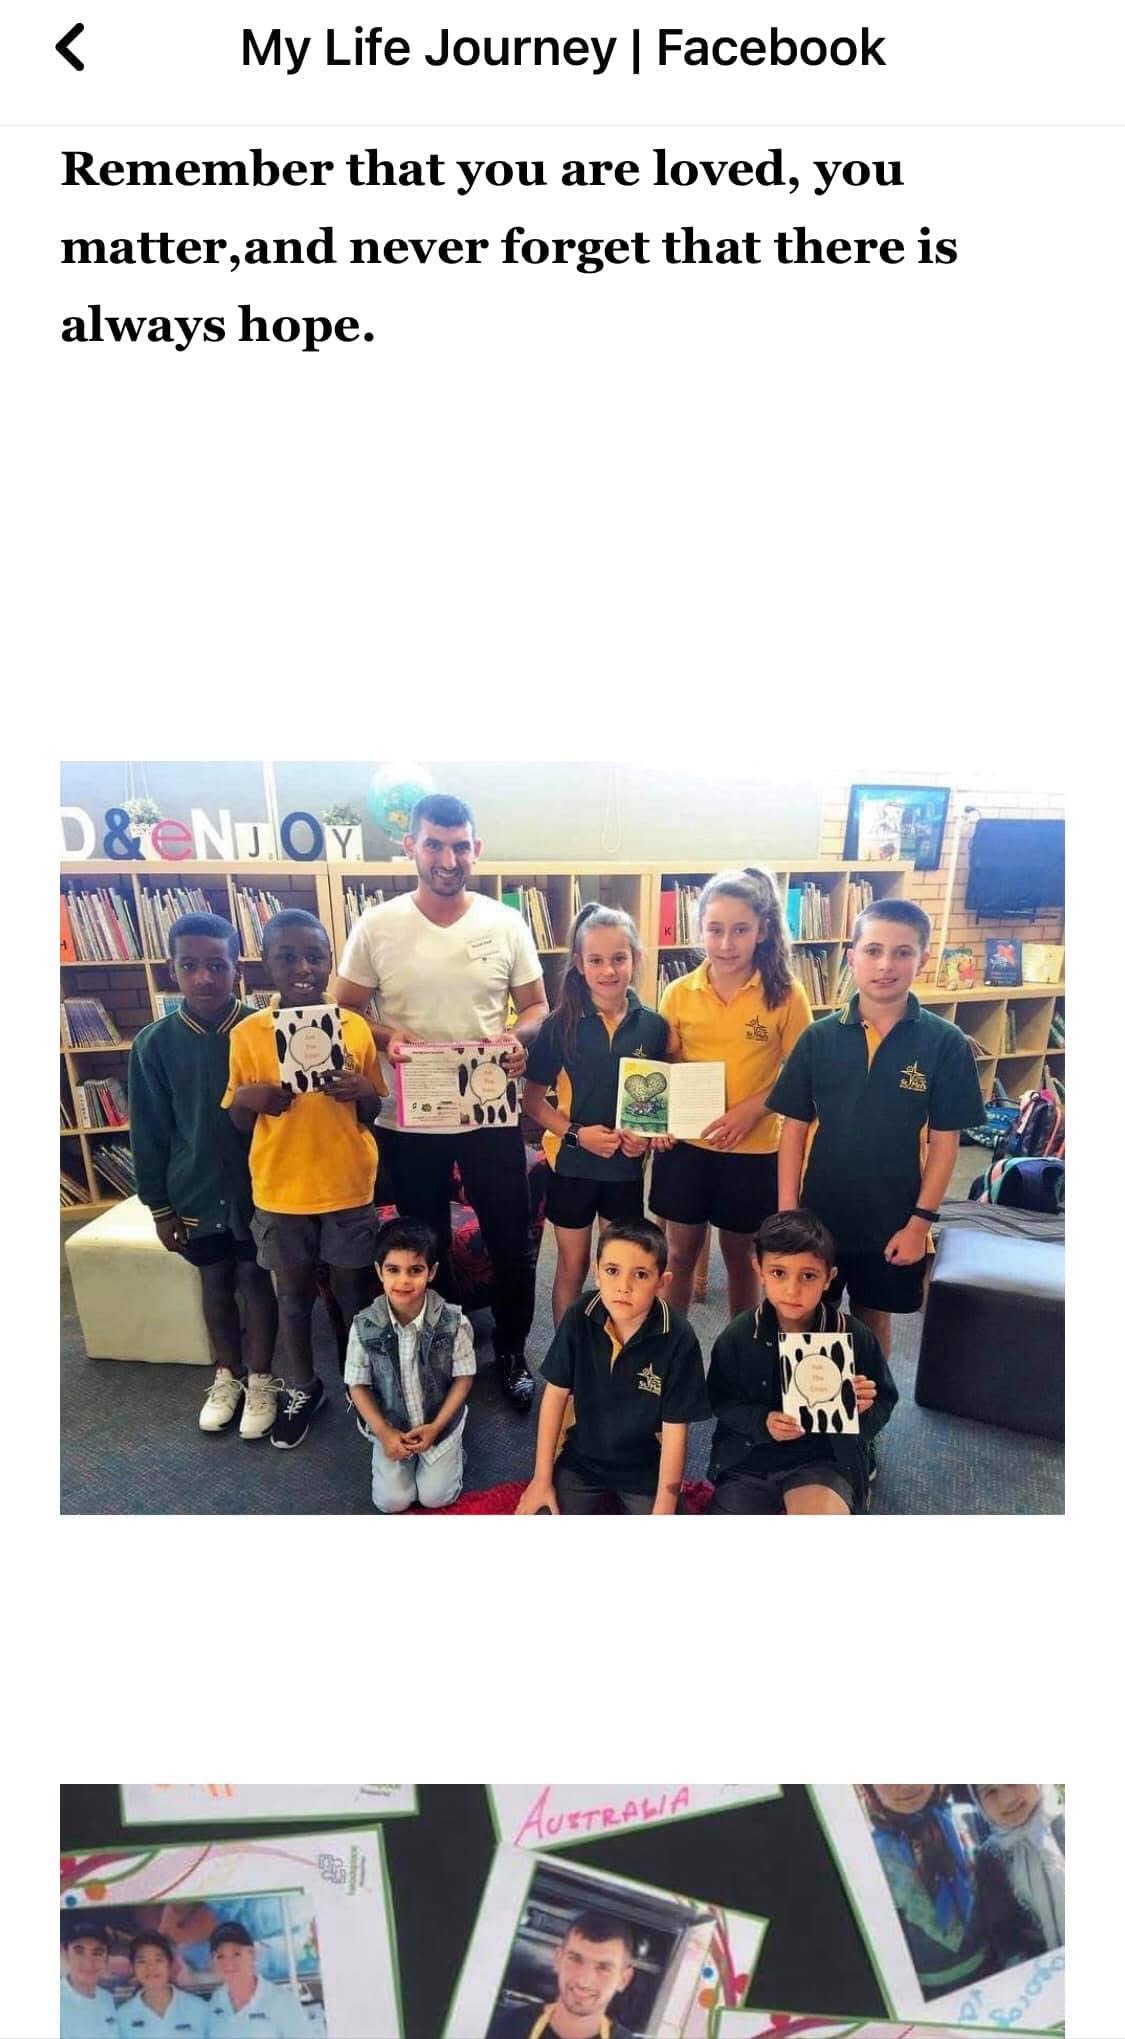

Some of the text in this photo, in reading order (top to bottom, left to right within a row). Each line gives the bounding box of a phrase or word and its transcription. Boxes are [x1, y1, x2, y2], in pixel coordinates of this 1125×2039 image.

[242, 28, 312, 76] My
[326, 25, 411, 66] Life
[424, 28, 618, 76] Journey
[658, 26, 887, 67] Facebook
[61, 148, 905, 196] Remember that you are loved, you
[60, 226, 958, 274] matter,and never forget that there is
[61, 303, 374, 353] always hope.
[664, 927, 672, 937] K
[514, 1784, 690, 1847] AUSTRALIA
